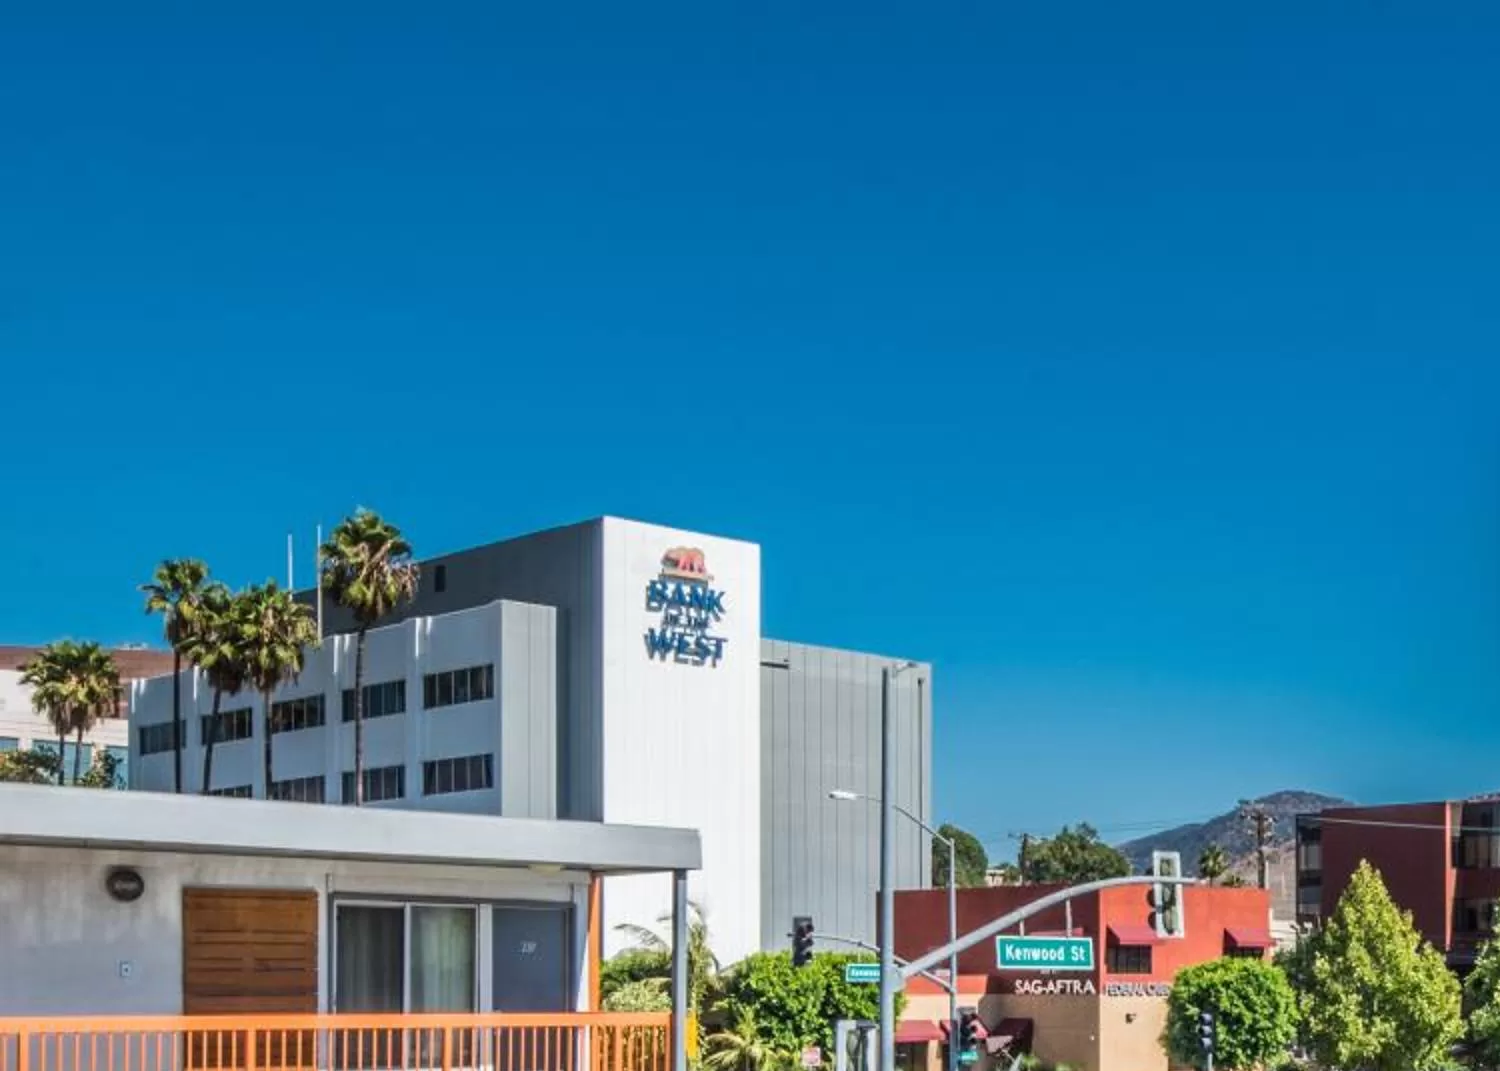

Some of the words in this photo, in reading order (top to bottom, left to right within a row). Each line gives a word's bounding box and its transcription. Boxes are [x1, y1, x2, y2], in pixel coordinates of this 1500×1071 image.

[645, 577, 726, 622] BANK
[644, 628, 728, 668] WEST
[1005, 943, 1065, 961] Kenwood
[1071, 945, 1085, 961] St
[1015, 979, 1097, 995] SAG-AFTRA
